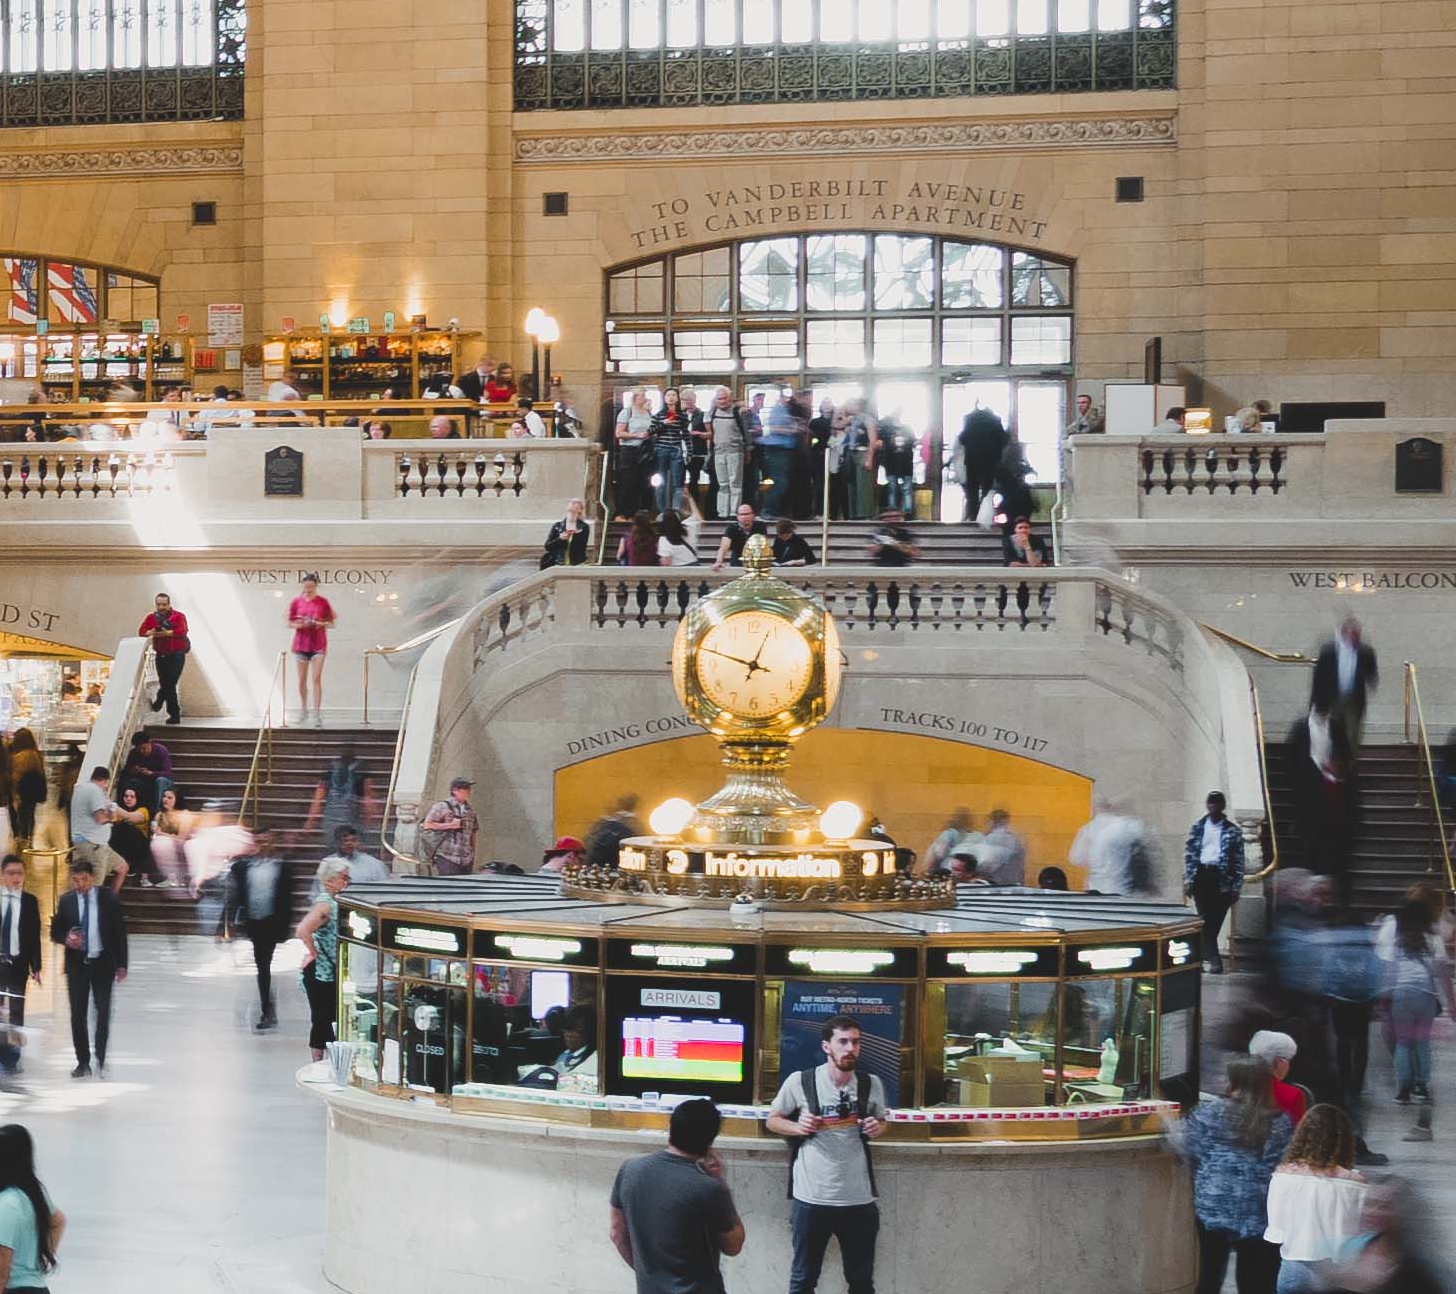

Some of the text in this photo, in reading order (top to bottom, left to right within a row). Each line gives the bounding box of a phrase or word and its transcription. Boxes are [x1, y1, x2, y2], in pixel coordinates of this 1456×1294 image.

[653, 180, 1026, 218] TO VANDERBILT AVENUE
[631, 204, 1048, 248] THE CAMPBELL APARTMENT
[237, 569, 291, 584] WEST
[1289, 572, 1354, 588] WEST
[28, 609, 61, 633] ST
[566, 723, 642, 756] DINING
[879, 707, 1049, 753] TRACKS 100 TO 117
[704, 851, 840, 879] Information
[644, 991, 716, 1007] ARRIVALS
[839, 1005, 895, 1014] ANYWHERE
